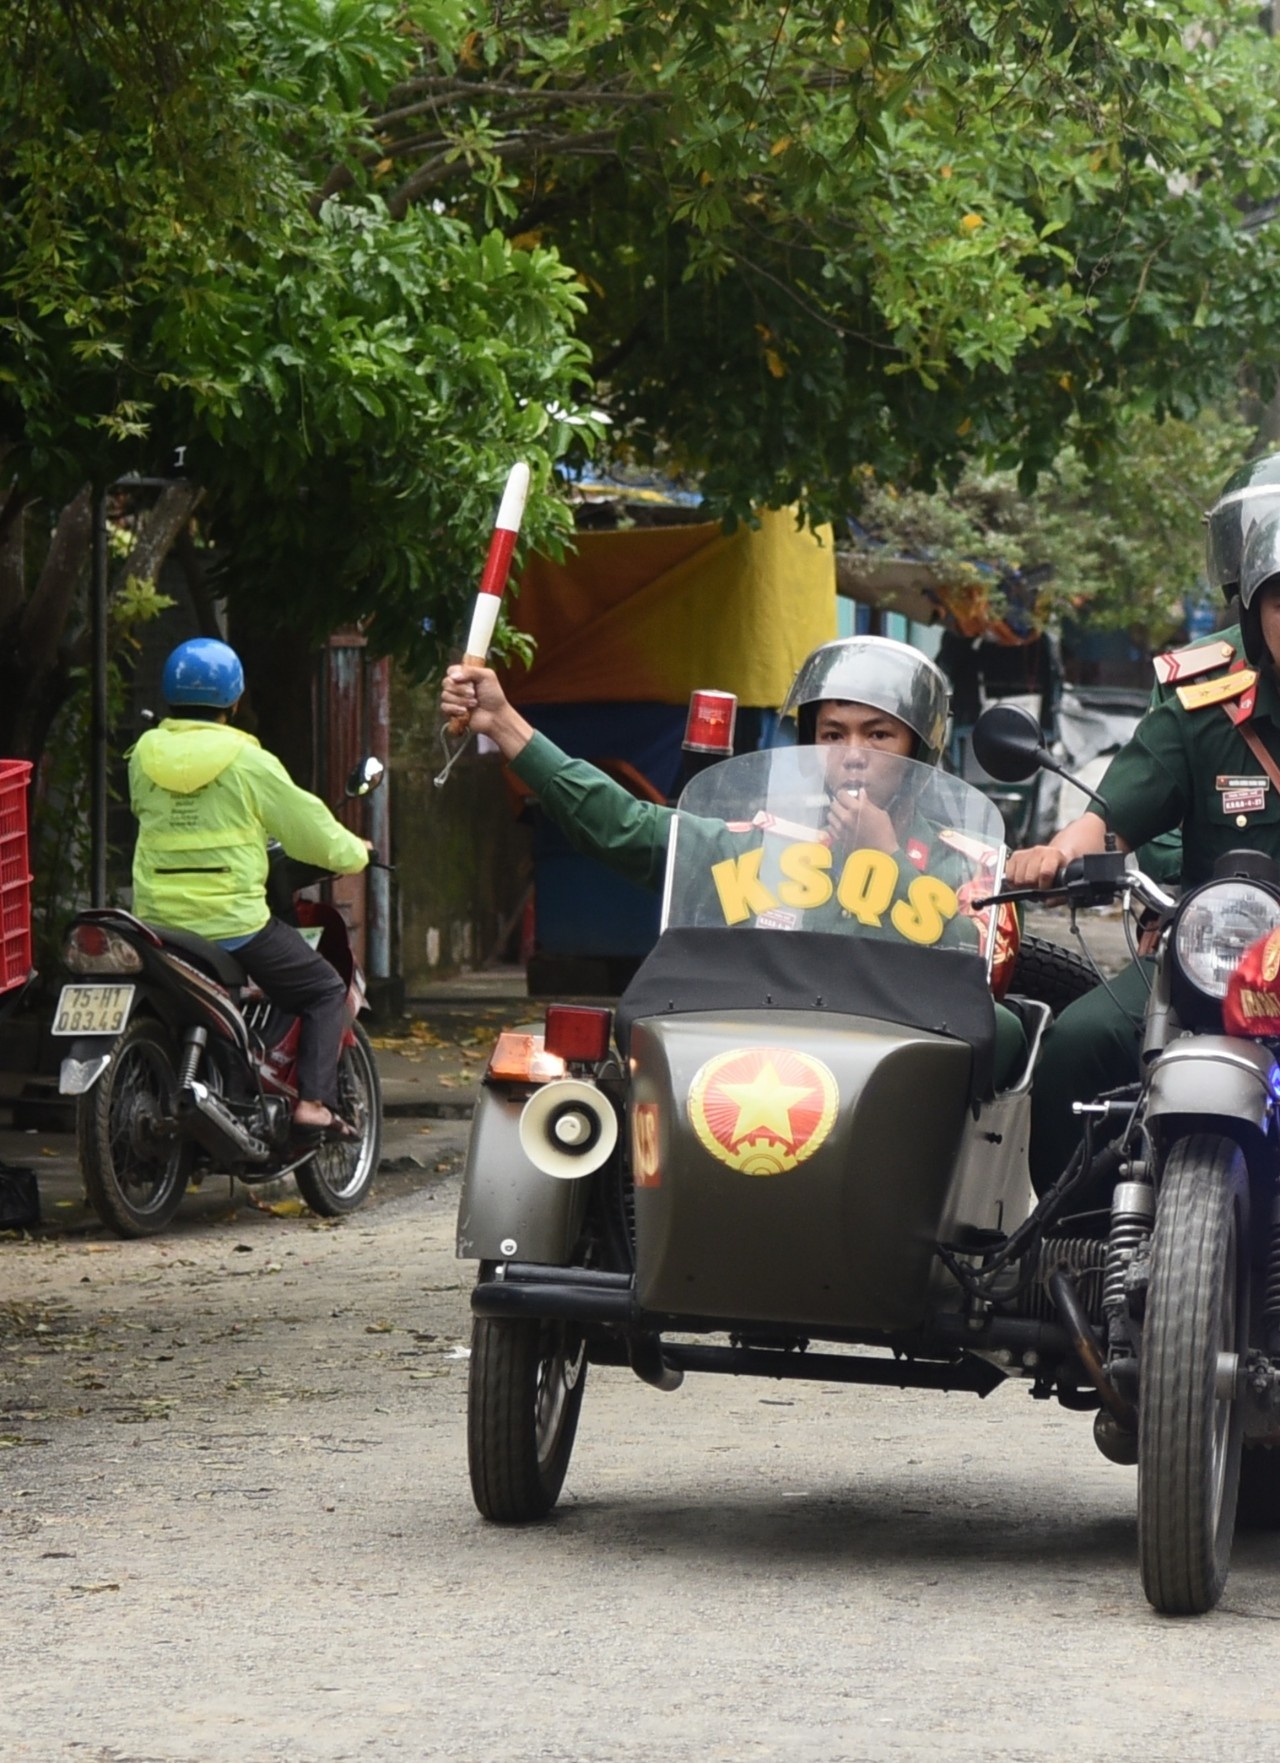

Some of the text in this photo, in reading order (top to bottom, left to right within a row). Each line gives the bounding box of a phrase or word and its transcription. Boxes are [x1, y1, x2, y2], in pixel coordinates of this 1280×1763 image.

[711, 842, 959, 945] KSQS
[72, 988, 121, 1008] 75-H1
[58, 1011, 124, 1031] 083.49
